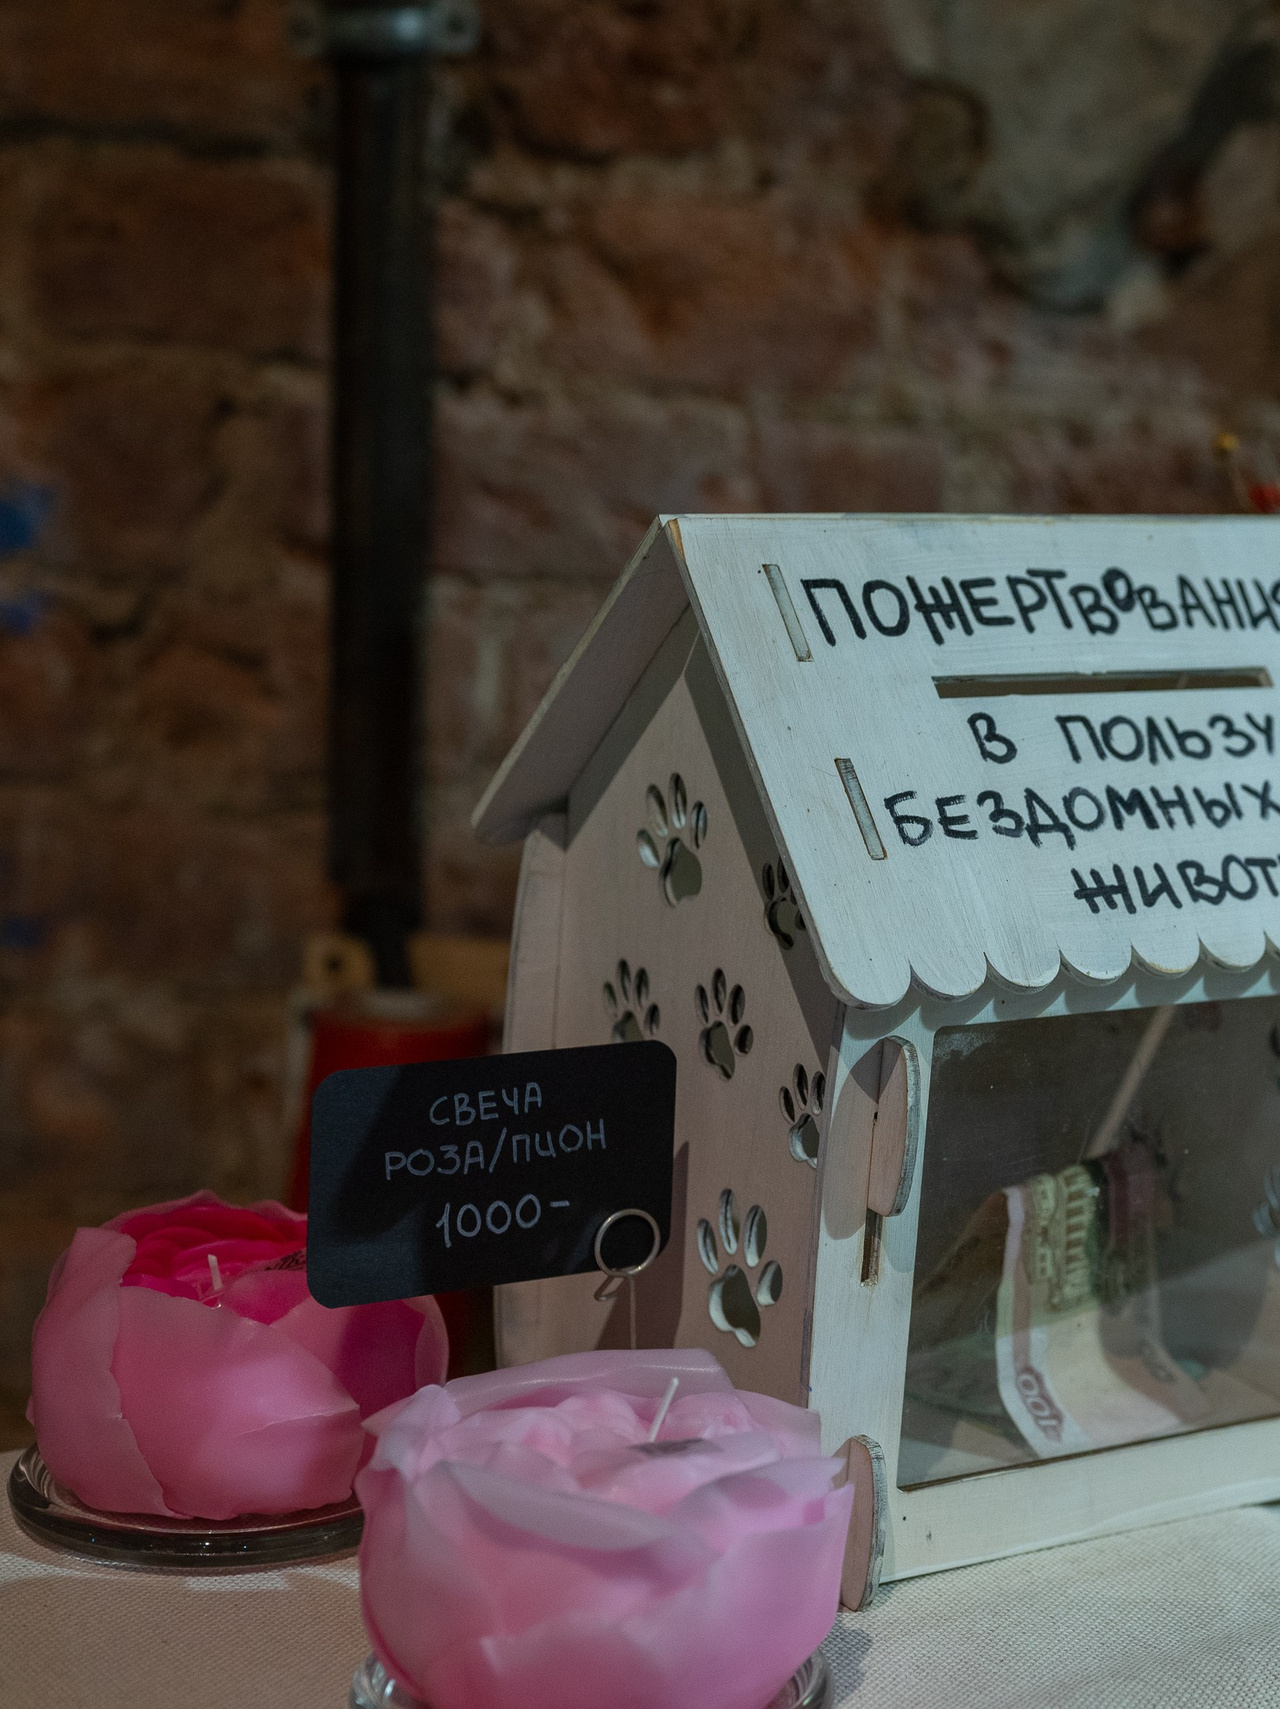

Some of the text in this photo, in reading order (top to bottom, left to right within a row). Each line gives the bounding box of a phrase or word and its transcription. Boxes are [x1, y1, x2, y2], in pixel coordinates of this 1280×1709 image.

[1056, 714, 1277, 764] ПОЛЬЗУ
[429, 1082, 543, 1126] СВЕЧА
[384, 1118, 607, 1181] РОЗА/ПИОН
